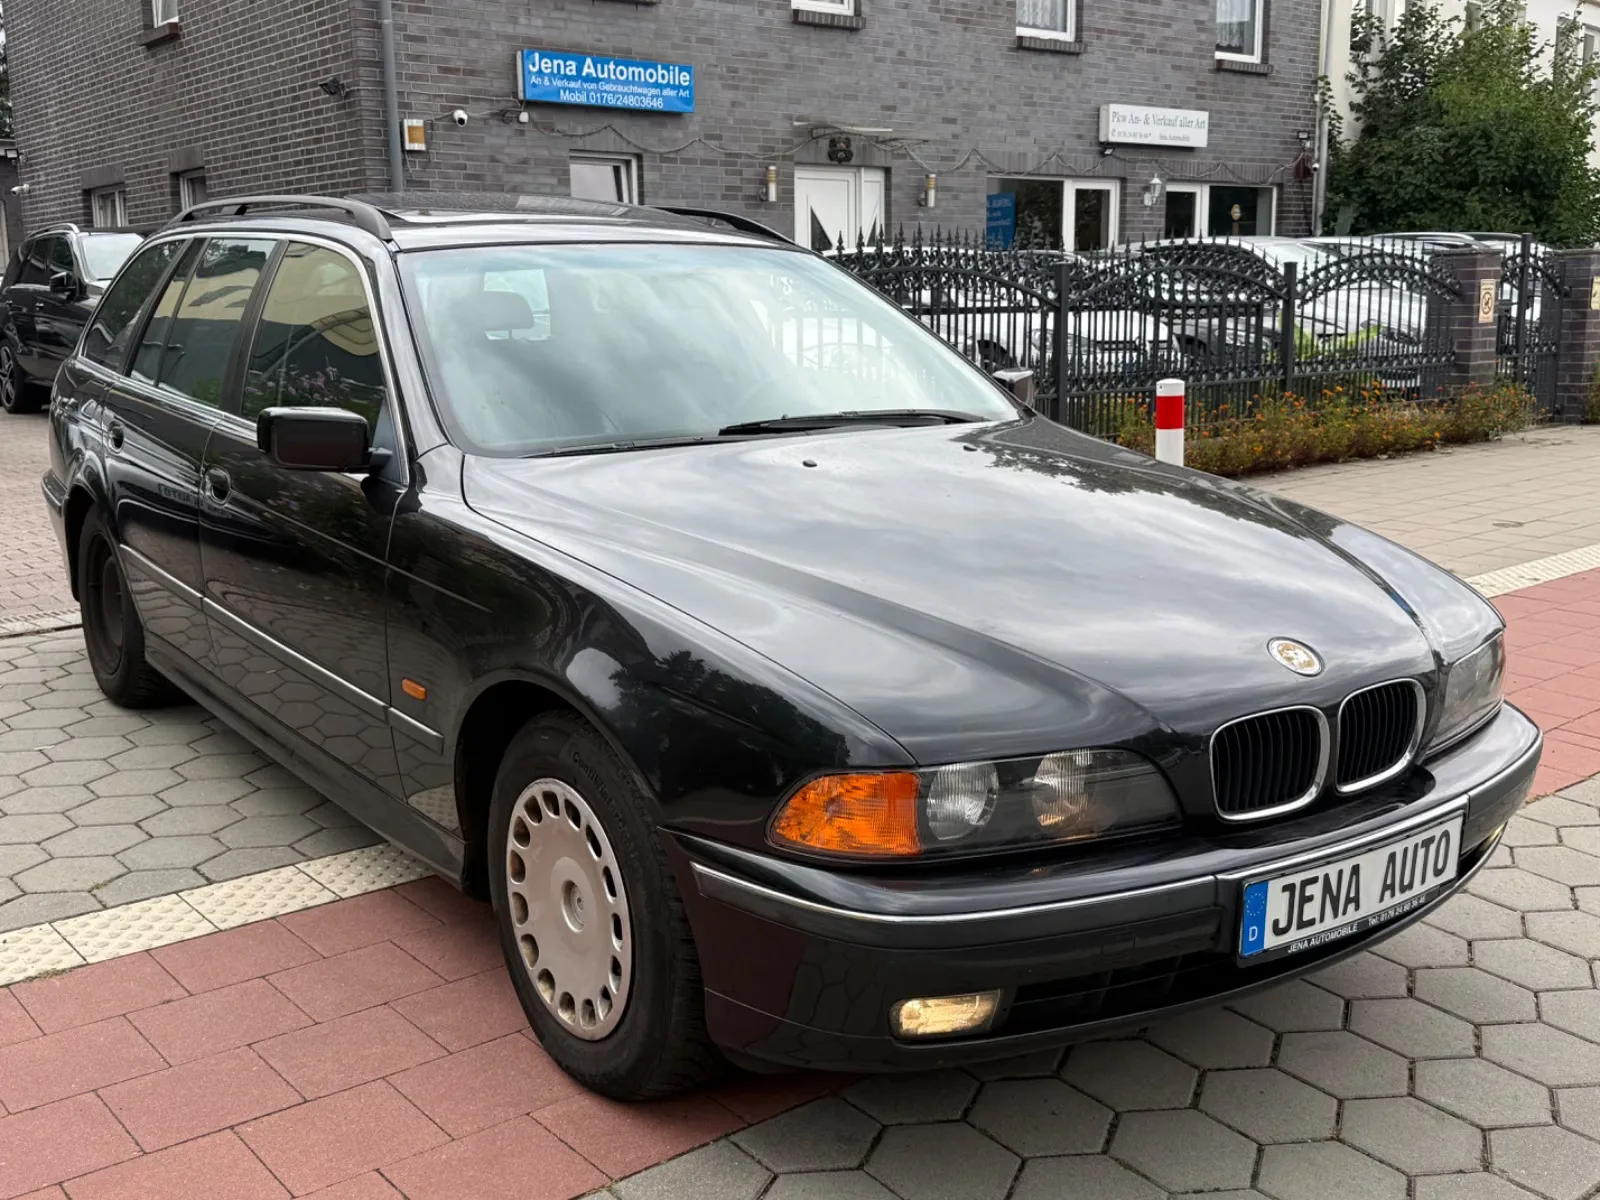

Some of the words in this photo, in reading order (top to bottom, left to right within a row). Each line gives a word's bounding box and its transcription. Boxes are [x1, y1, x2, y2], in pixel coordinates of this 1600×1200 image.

[528, 52, 577, 76] Jena
[581, 57, 690, 86] Automobile
[530, 75, 542, 85] An
[544, 76, 550, 86] &
[552, 77, 582, 88] Verkauf
[599, 82, 661, 96] Gebrauchtwagen
[662, 88, 678, 96] aller
[679, 89, 690, 98] Art
[560, 89, 587, 102] Mobil
[589, 91, 664, 109] 0176/24803646
[1143, 113, 1150, 125] &
[1272, 863, 1361, 937] JENA
[1378, 829, 1451, 904] AUTO
[1248, 926, 1258, 942] D
[1287, 939, 1309, 953] JENA
[1309, 922, 1358, 947] AUTOMOBILE
